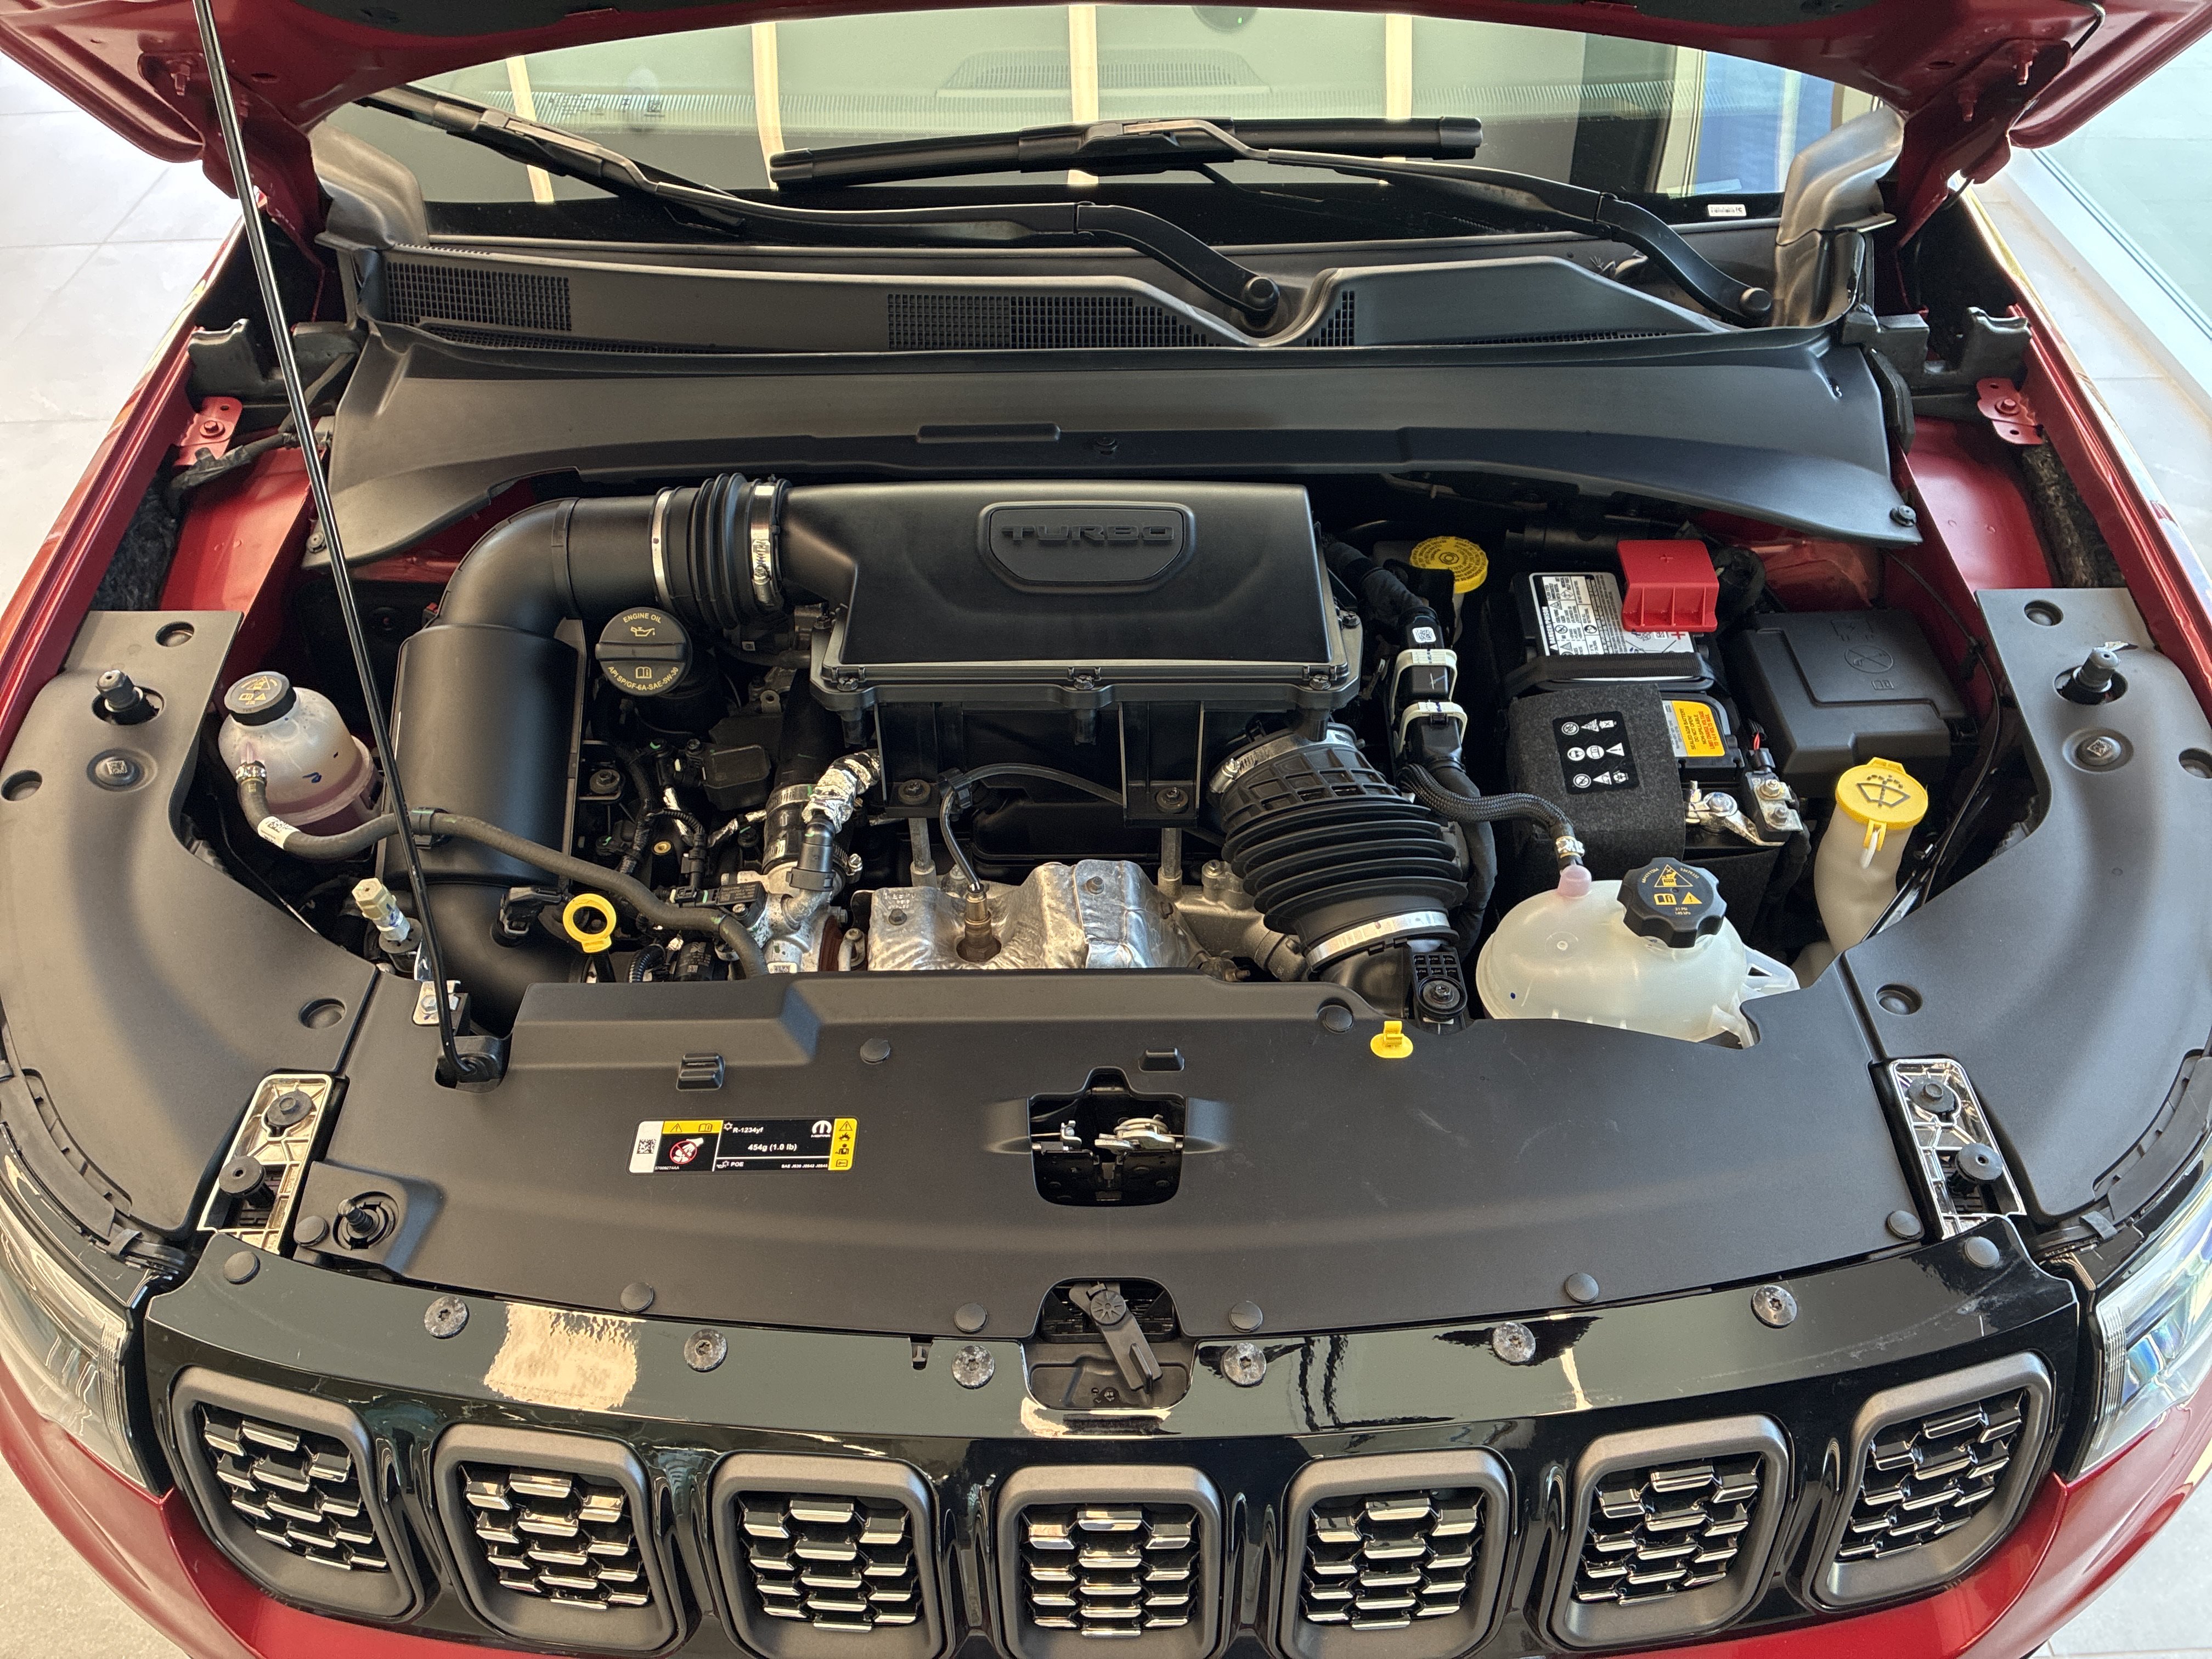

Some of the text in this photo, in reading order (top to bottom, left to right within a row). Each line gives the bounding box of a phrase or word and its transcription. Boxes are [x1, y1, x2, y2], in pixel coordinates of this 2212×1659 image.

[1001, 524, 1175, 543] TURBO
[623, 613, 662, 624] ENGINE OIL
[1541, 606, 1556, 643] DANGER/POISON
[608, 666, 679, 691] API SP/GF-6A-SAE-5W-30
